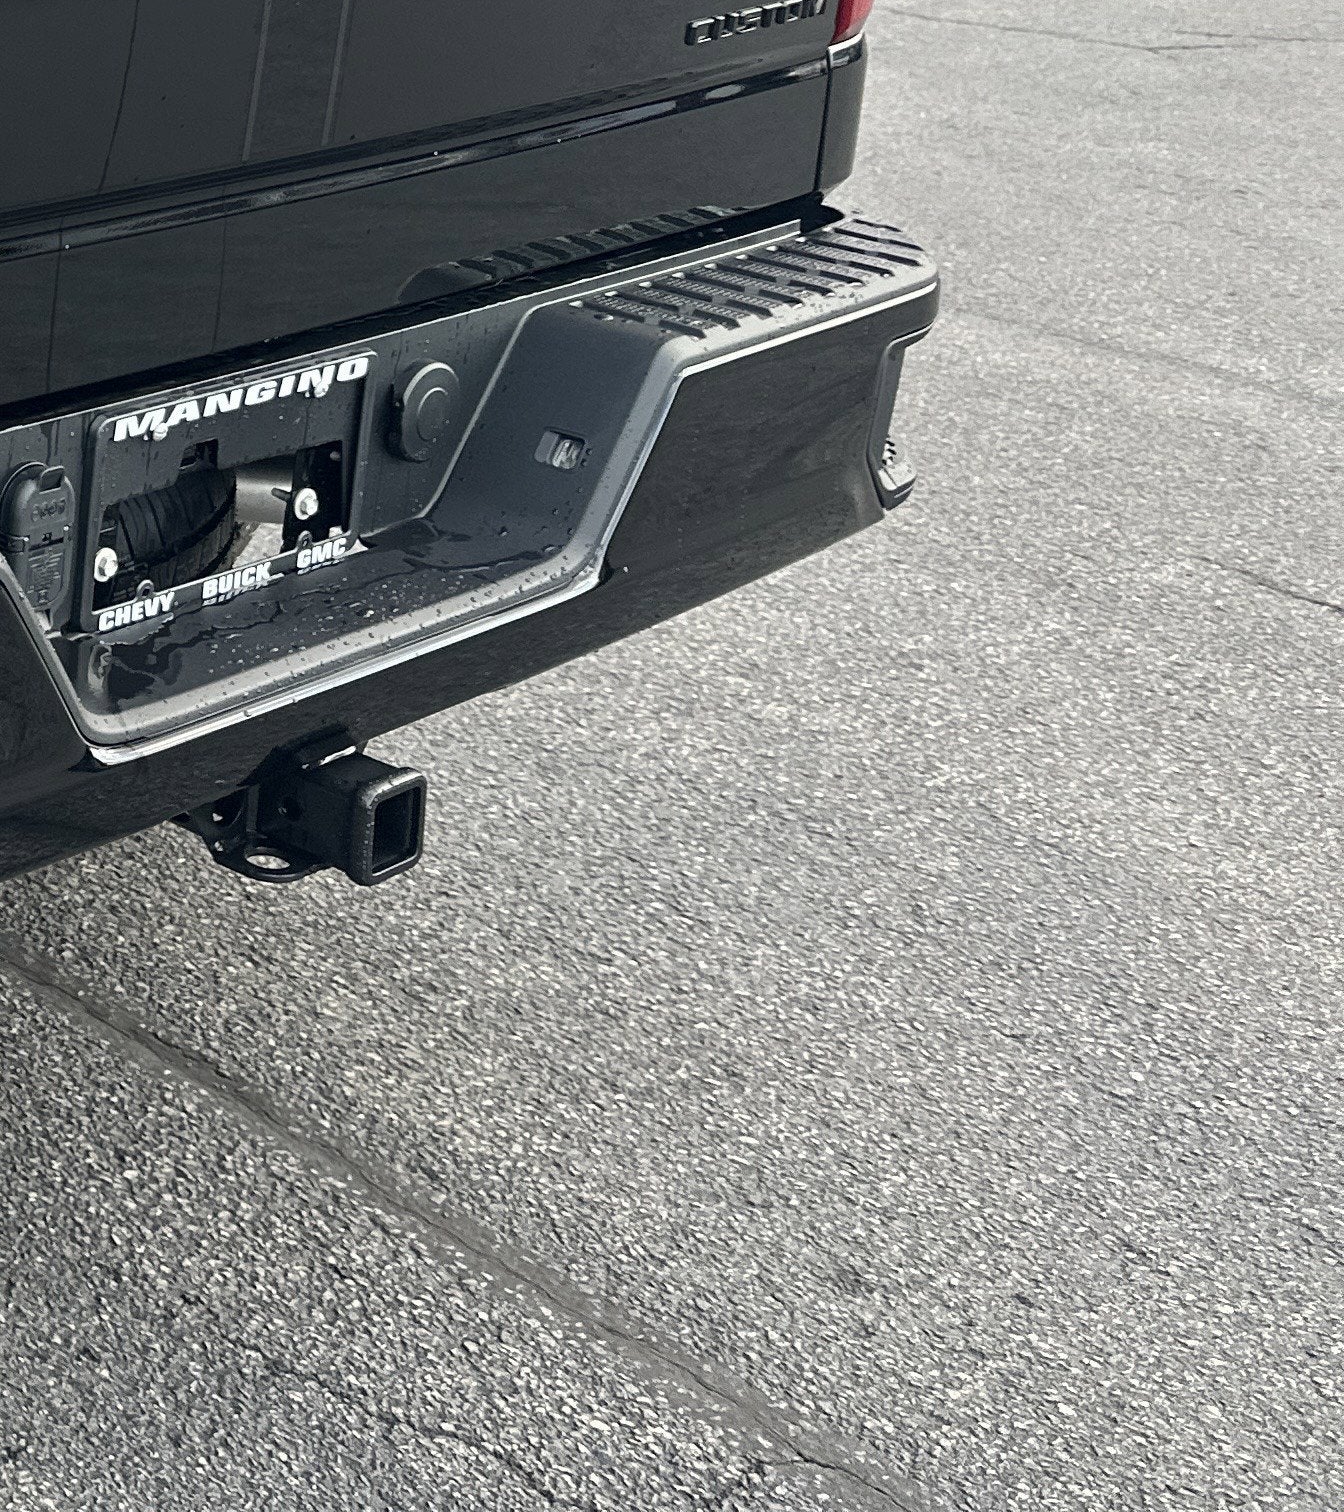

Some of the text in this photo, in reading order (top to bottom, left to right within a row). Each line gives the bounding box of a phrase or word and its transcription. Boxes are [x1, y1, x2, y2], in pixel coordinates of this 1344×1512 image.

[113, 357, 370, 443] MANGINO
[98, 536, 349, 632] CHEVY BUICK GMC
